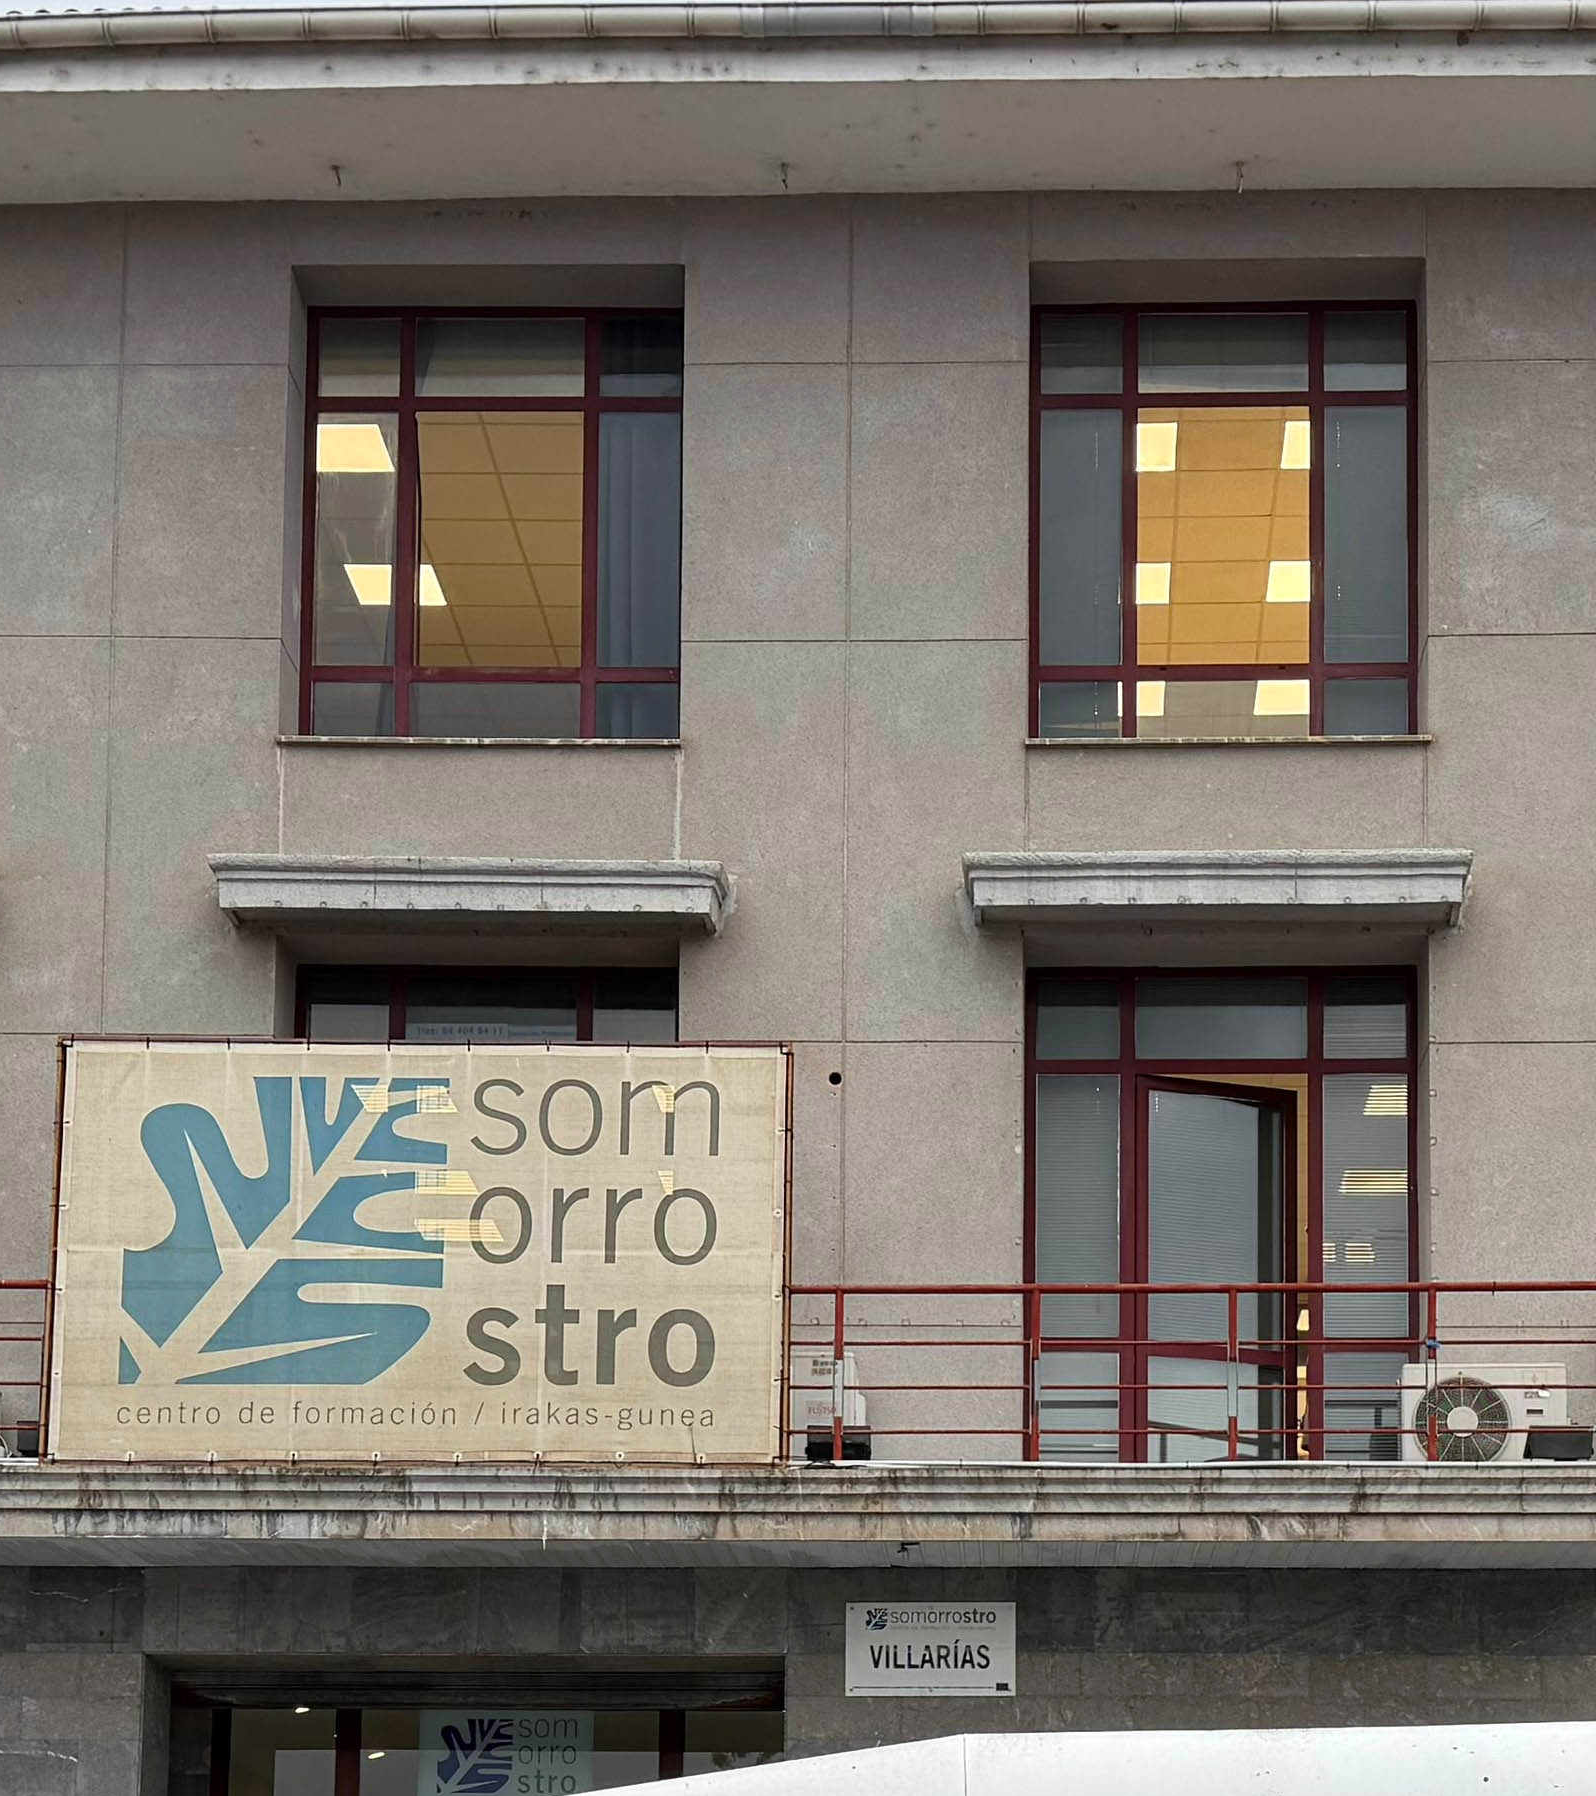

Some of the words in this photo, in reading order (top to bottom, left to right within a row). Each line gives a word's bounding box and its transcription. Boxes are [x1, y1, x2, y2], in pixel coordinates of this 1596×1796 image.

[471, 1079, 721, 1157] som
[469, 1187, 717, 1266] orro
[463, 1284, 716, 1387] stro
[117, 1402, 221, 1426] centro
[238, 1402, 275, 1425] de
[293, 1400, 457, 1426] formación
[502, 1401, 716, 1431] irakas-gunea
[890, 1608, 997, 1624] somorrostro
[870, 1639, 991, 1669] VILLARÍAS
[519, 1718, 578, 1738] som
[518, 1744, 577, 1765] orro
[517, 1770, 576, 1794] stro
